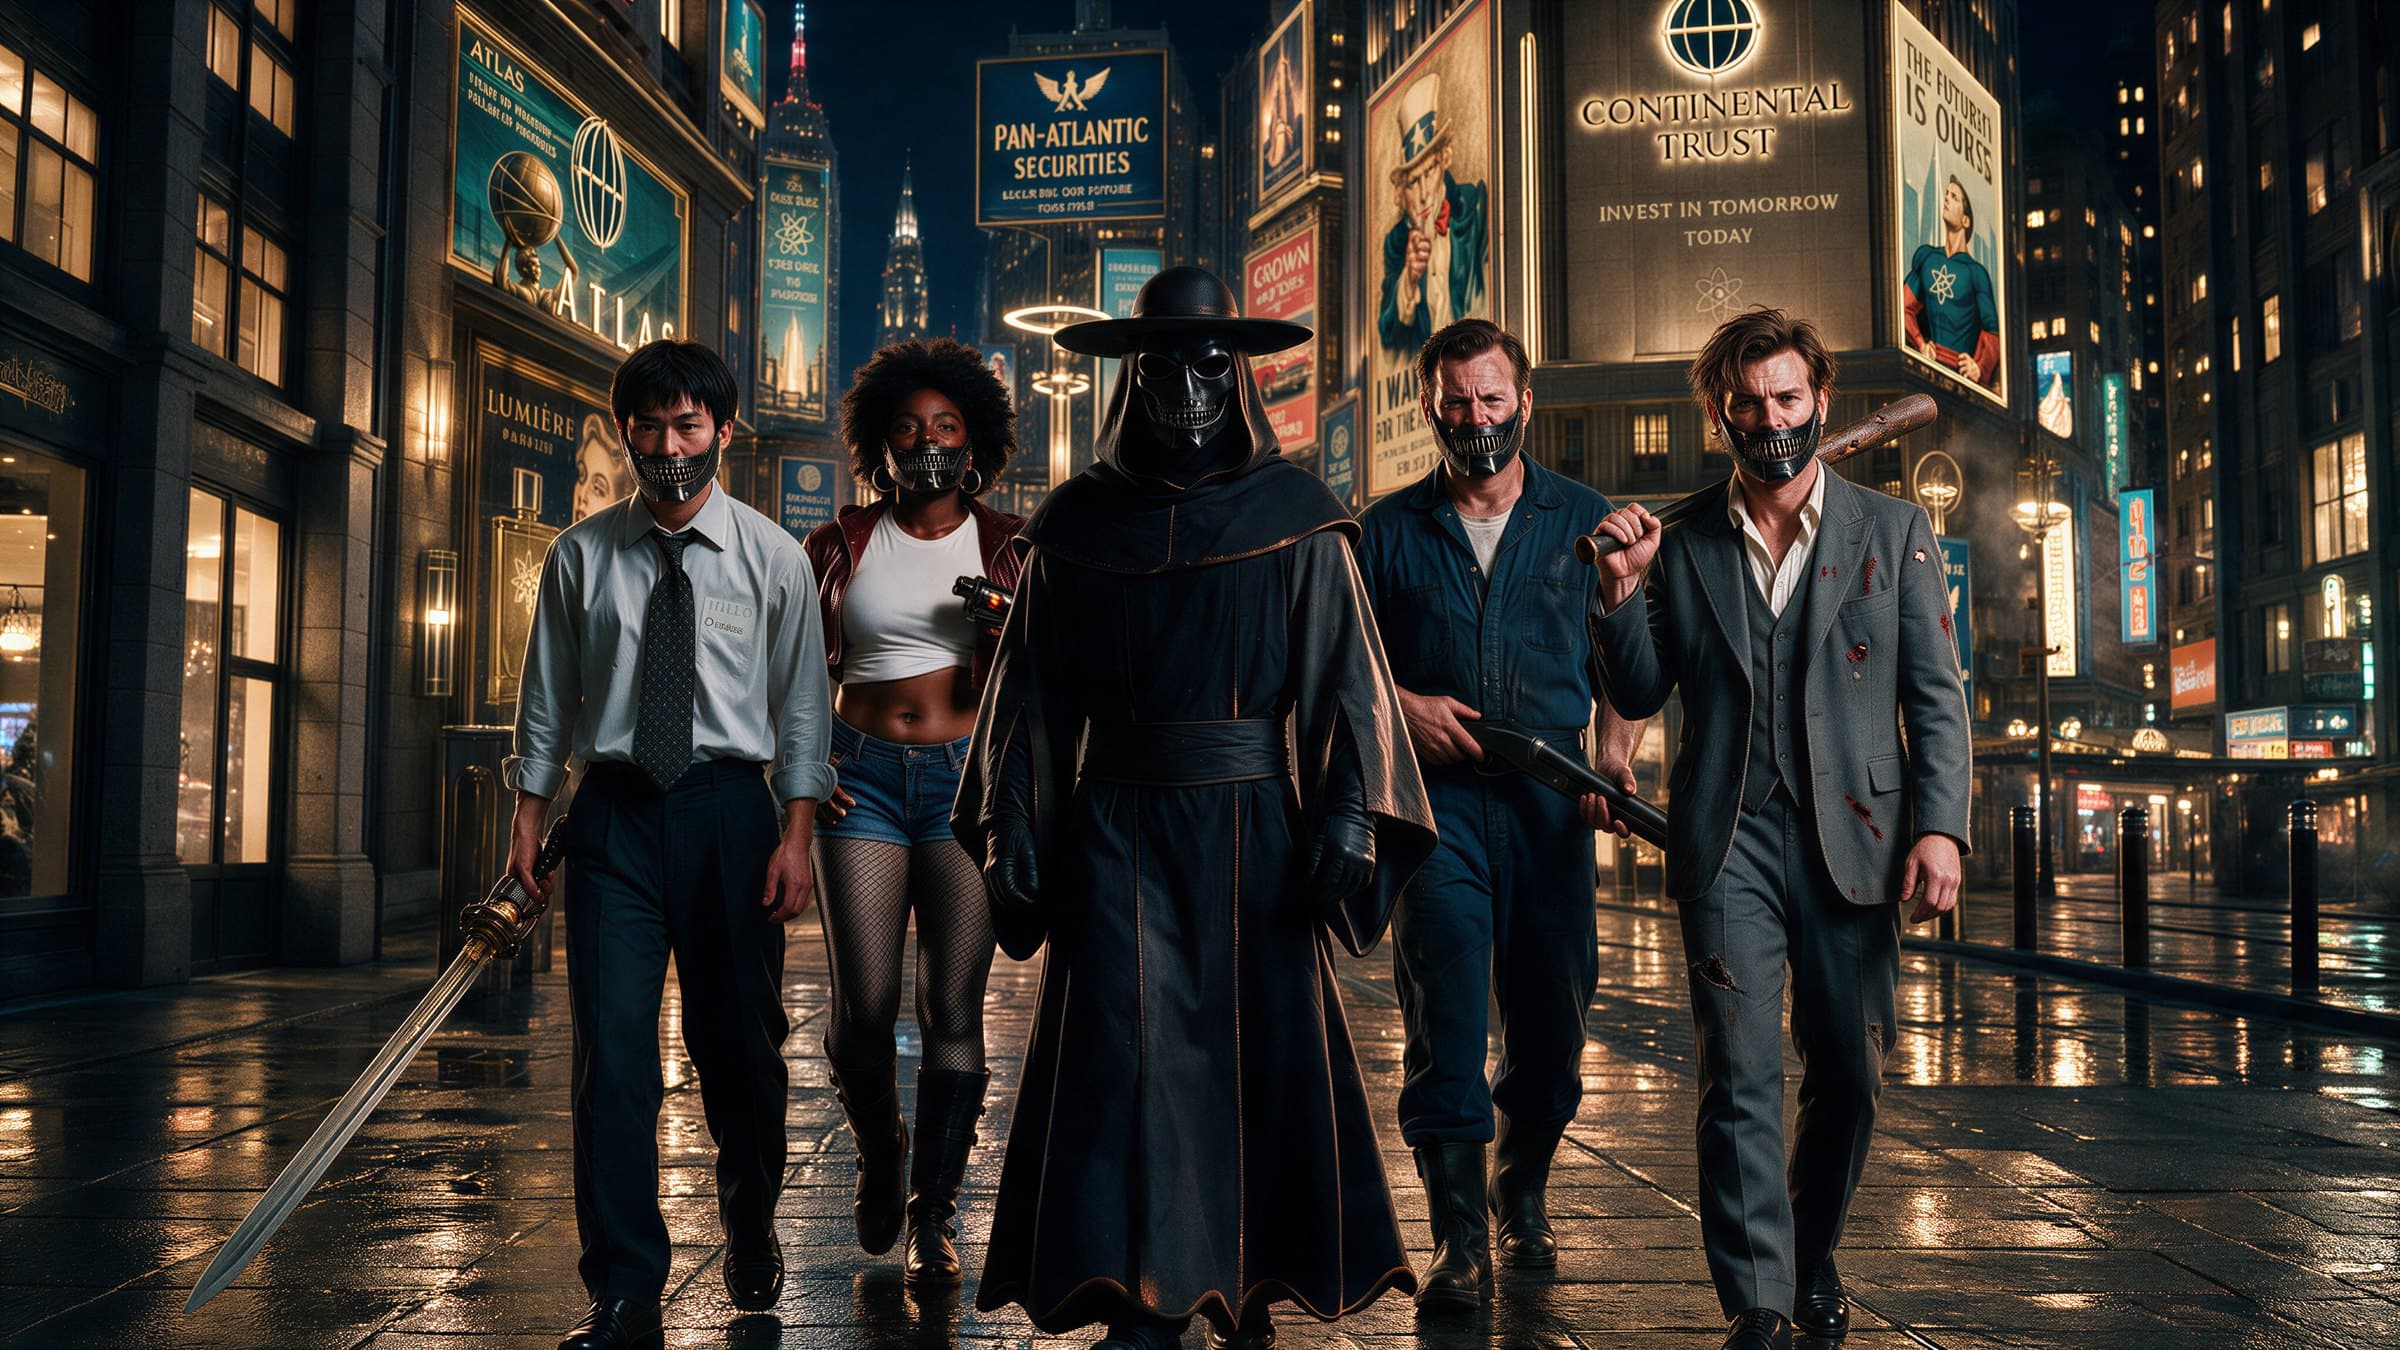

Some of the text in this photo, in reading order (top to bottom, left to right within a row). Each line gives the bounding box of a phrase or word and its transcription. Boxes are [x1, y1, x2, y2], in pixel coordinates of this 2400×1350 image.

[470, 39, 525, 93] ATLAS
[1904, 37, 1932, 86] THE
[1582, 83, 1850, 126] CONTINENTAL
[1906, 72, 1926, 126] IS
[994, 116, 1149, 151] PAN-ATLANTIC
[1657, 127, 1774, 160] TRUST
[1014, 151, 1131, 180] SECURITIES
[1600, 193, 1839, 222] INVEST IN TOMORROW
[1684, 227, 1753, 247] TODAY
[1377, 380, 1382, 415] I
